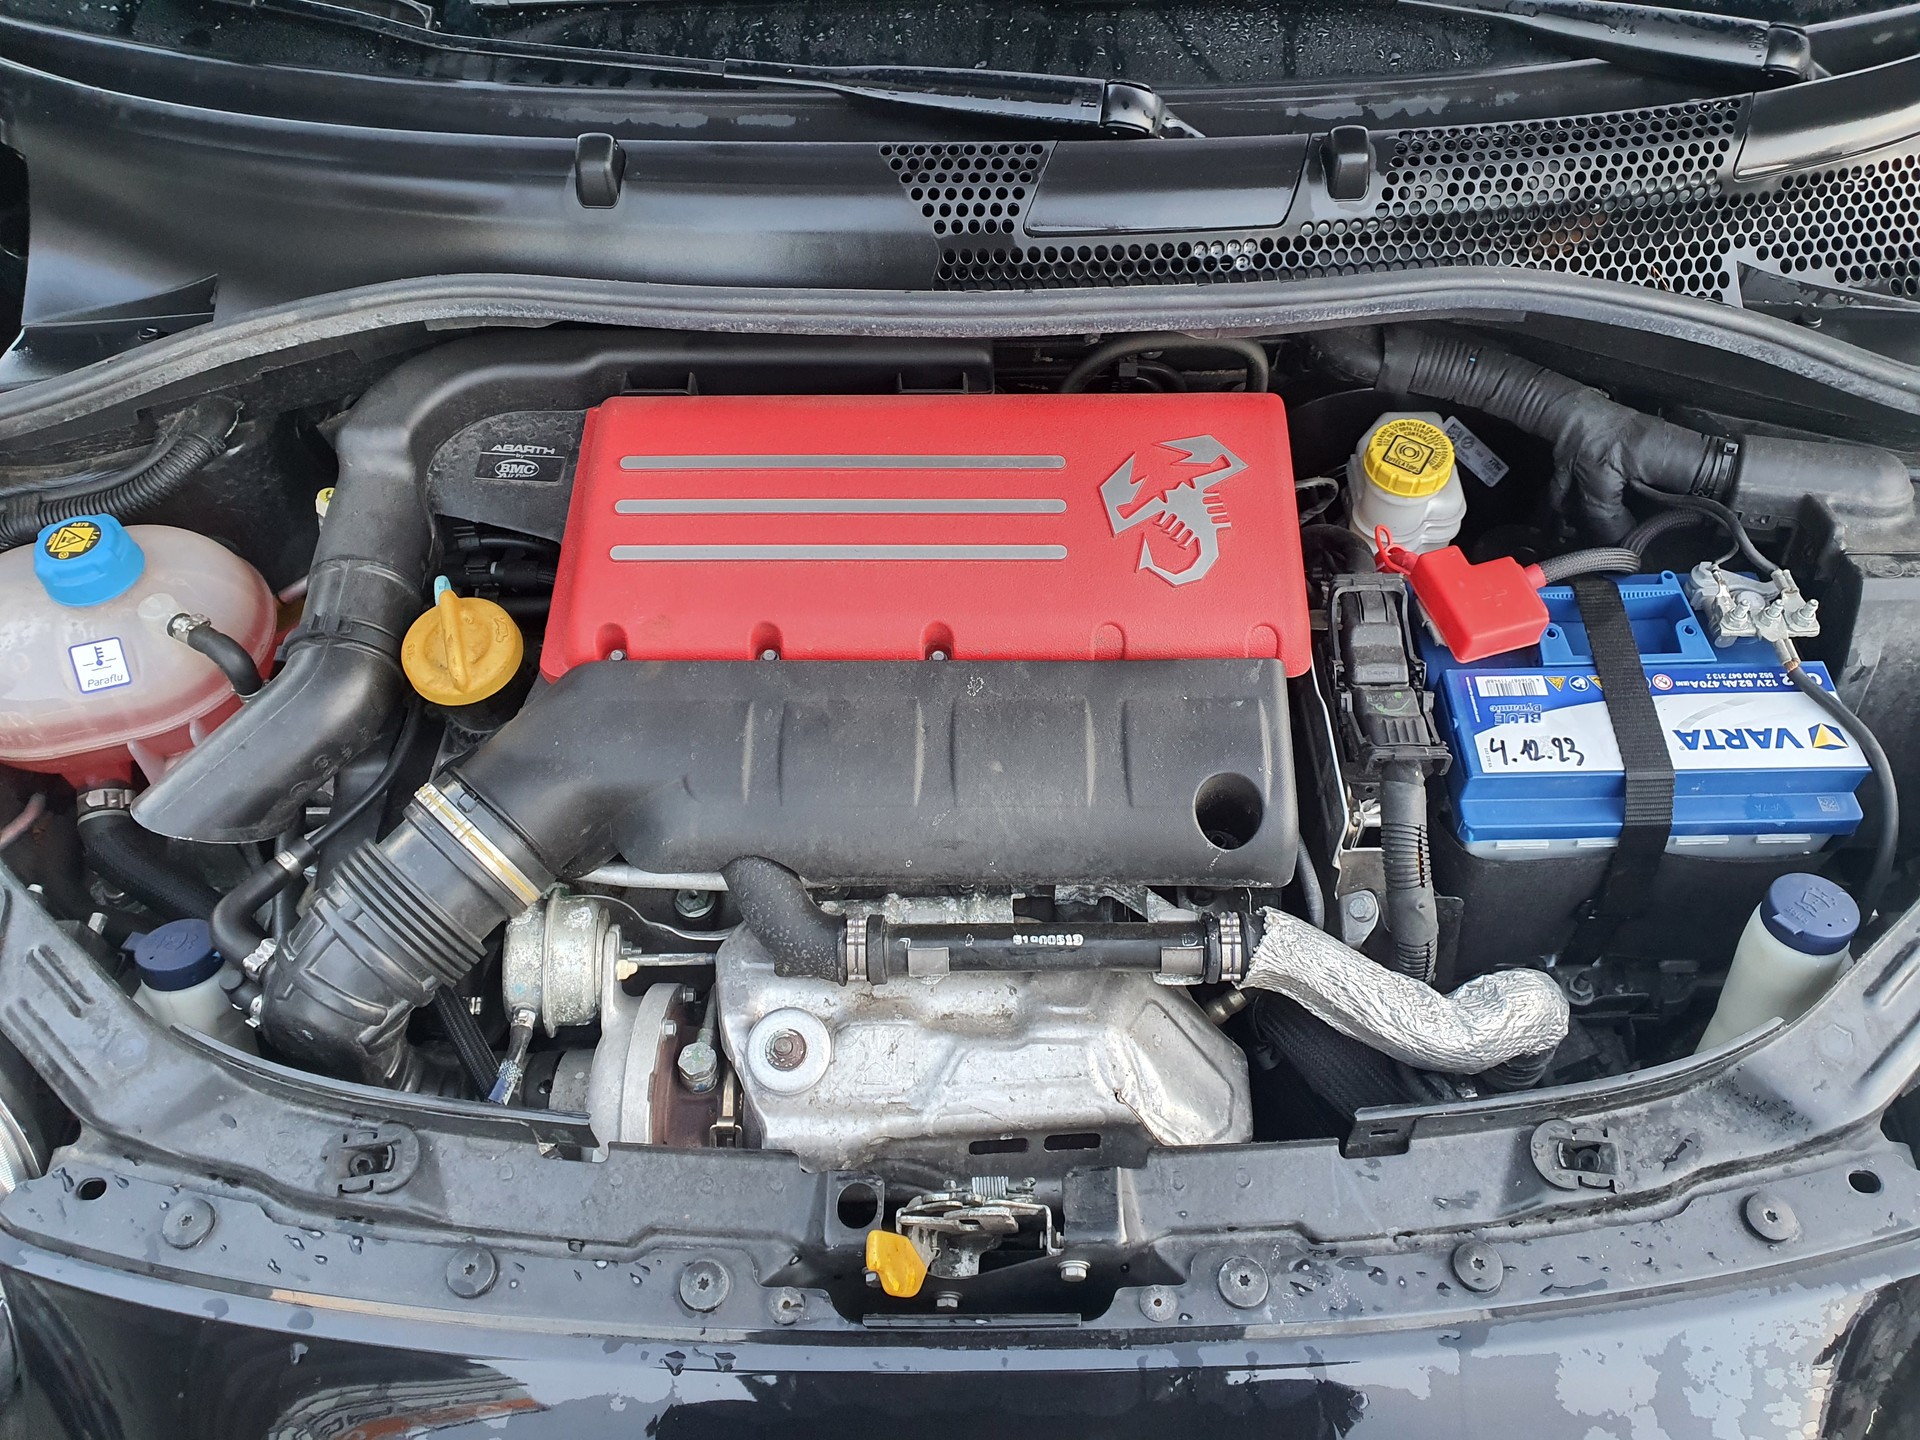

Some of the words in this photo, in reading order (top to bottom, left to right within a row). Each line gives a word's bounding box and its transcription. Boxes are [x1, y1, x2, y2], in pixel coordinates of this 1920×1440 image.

[491, 444, 556, 454] ABARTH
[499, 463, 536, 475] BMC
[87, 673, 124, 688] Paraflu
[1723, 679, 1754, 688] 52Ah
[1757, 679, 1779, 687] 12V
[1489, 702, 1542, 713] Dynamic
[1494, 712, 1542, 726] BLUE
[1672, 728, 1805, 750] VARTA
